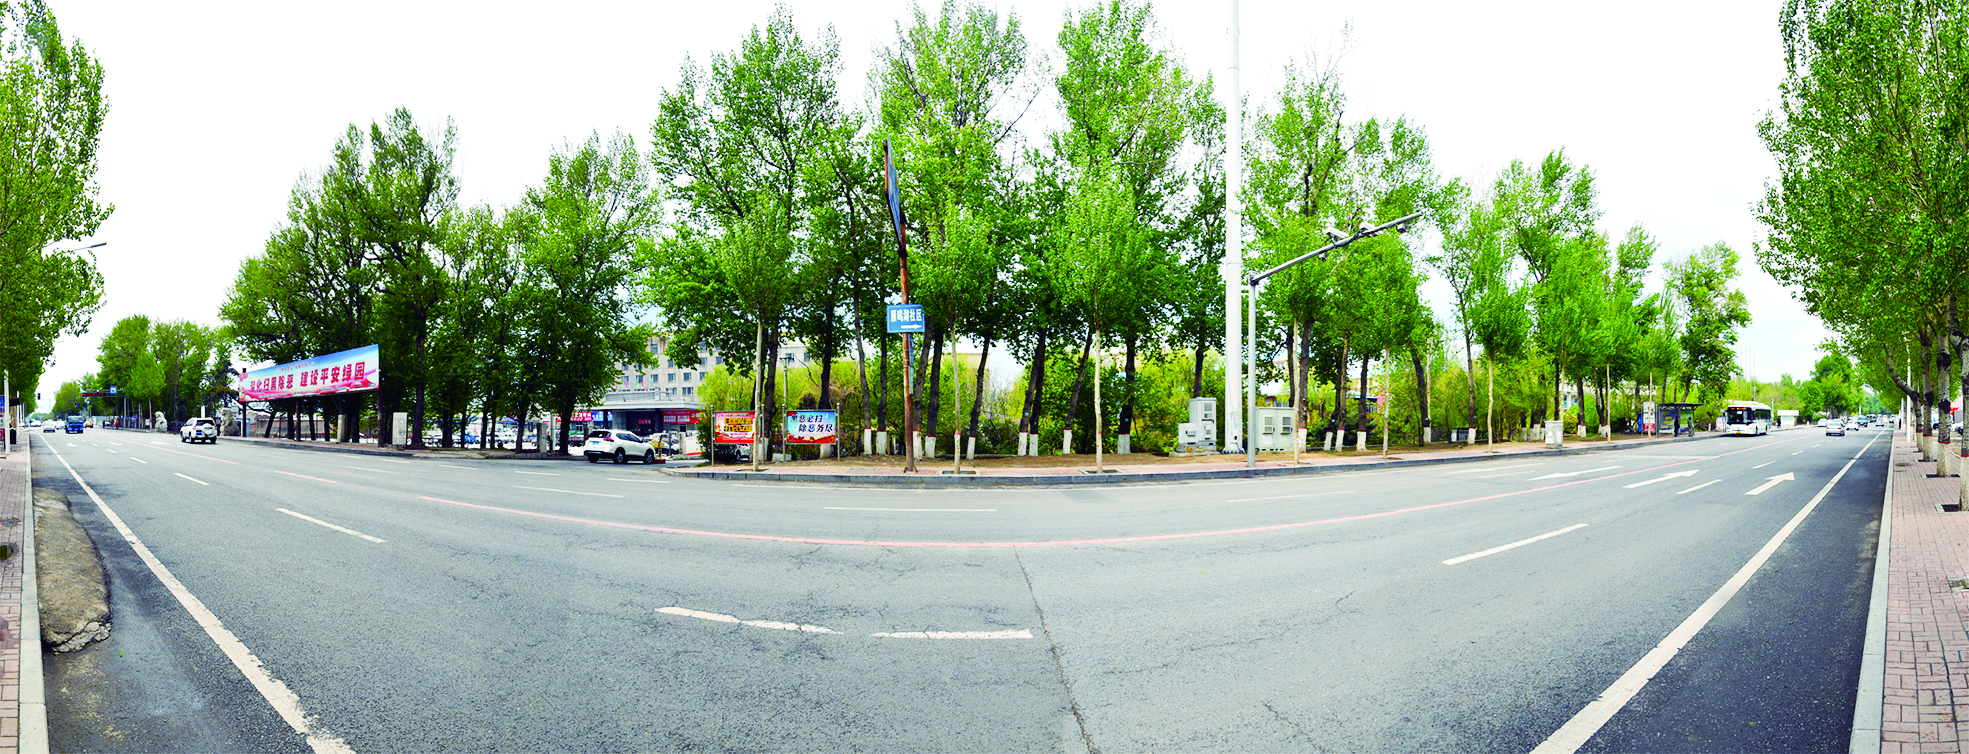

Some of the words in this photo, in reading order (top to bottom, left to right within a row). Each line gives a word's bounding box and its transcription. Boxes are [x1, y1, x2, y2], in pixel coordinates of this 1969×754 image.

[890, 308, 922, 322] 雁鸣湖社区
[300, 362, 365, 387] 建设平安绿园
[790, 414, 823, 423] 黑恶必扫
[798, 423, 833, 432] 除恶务尽
